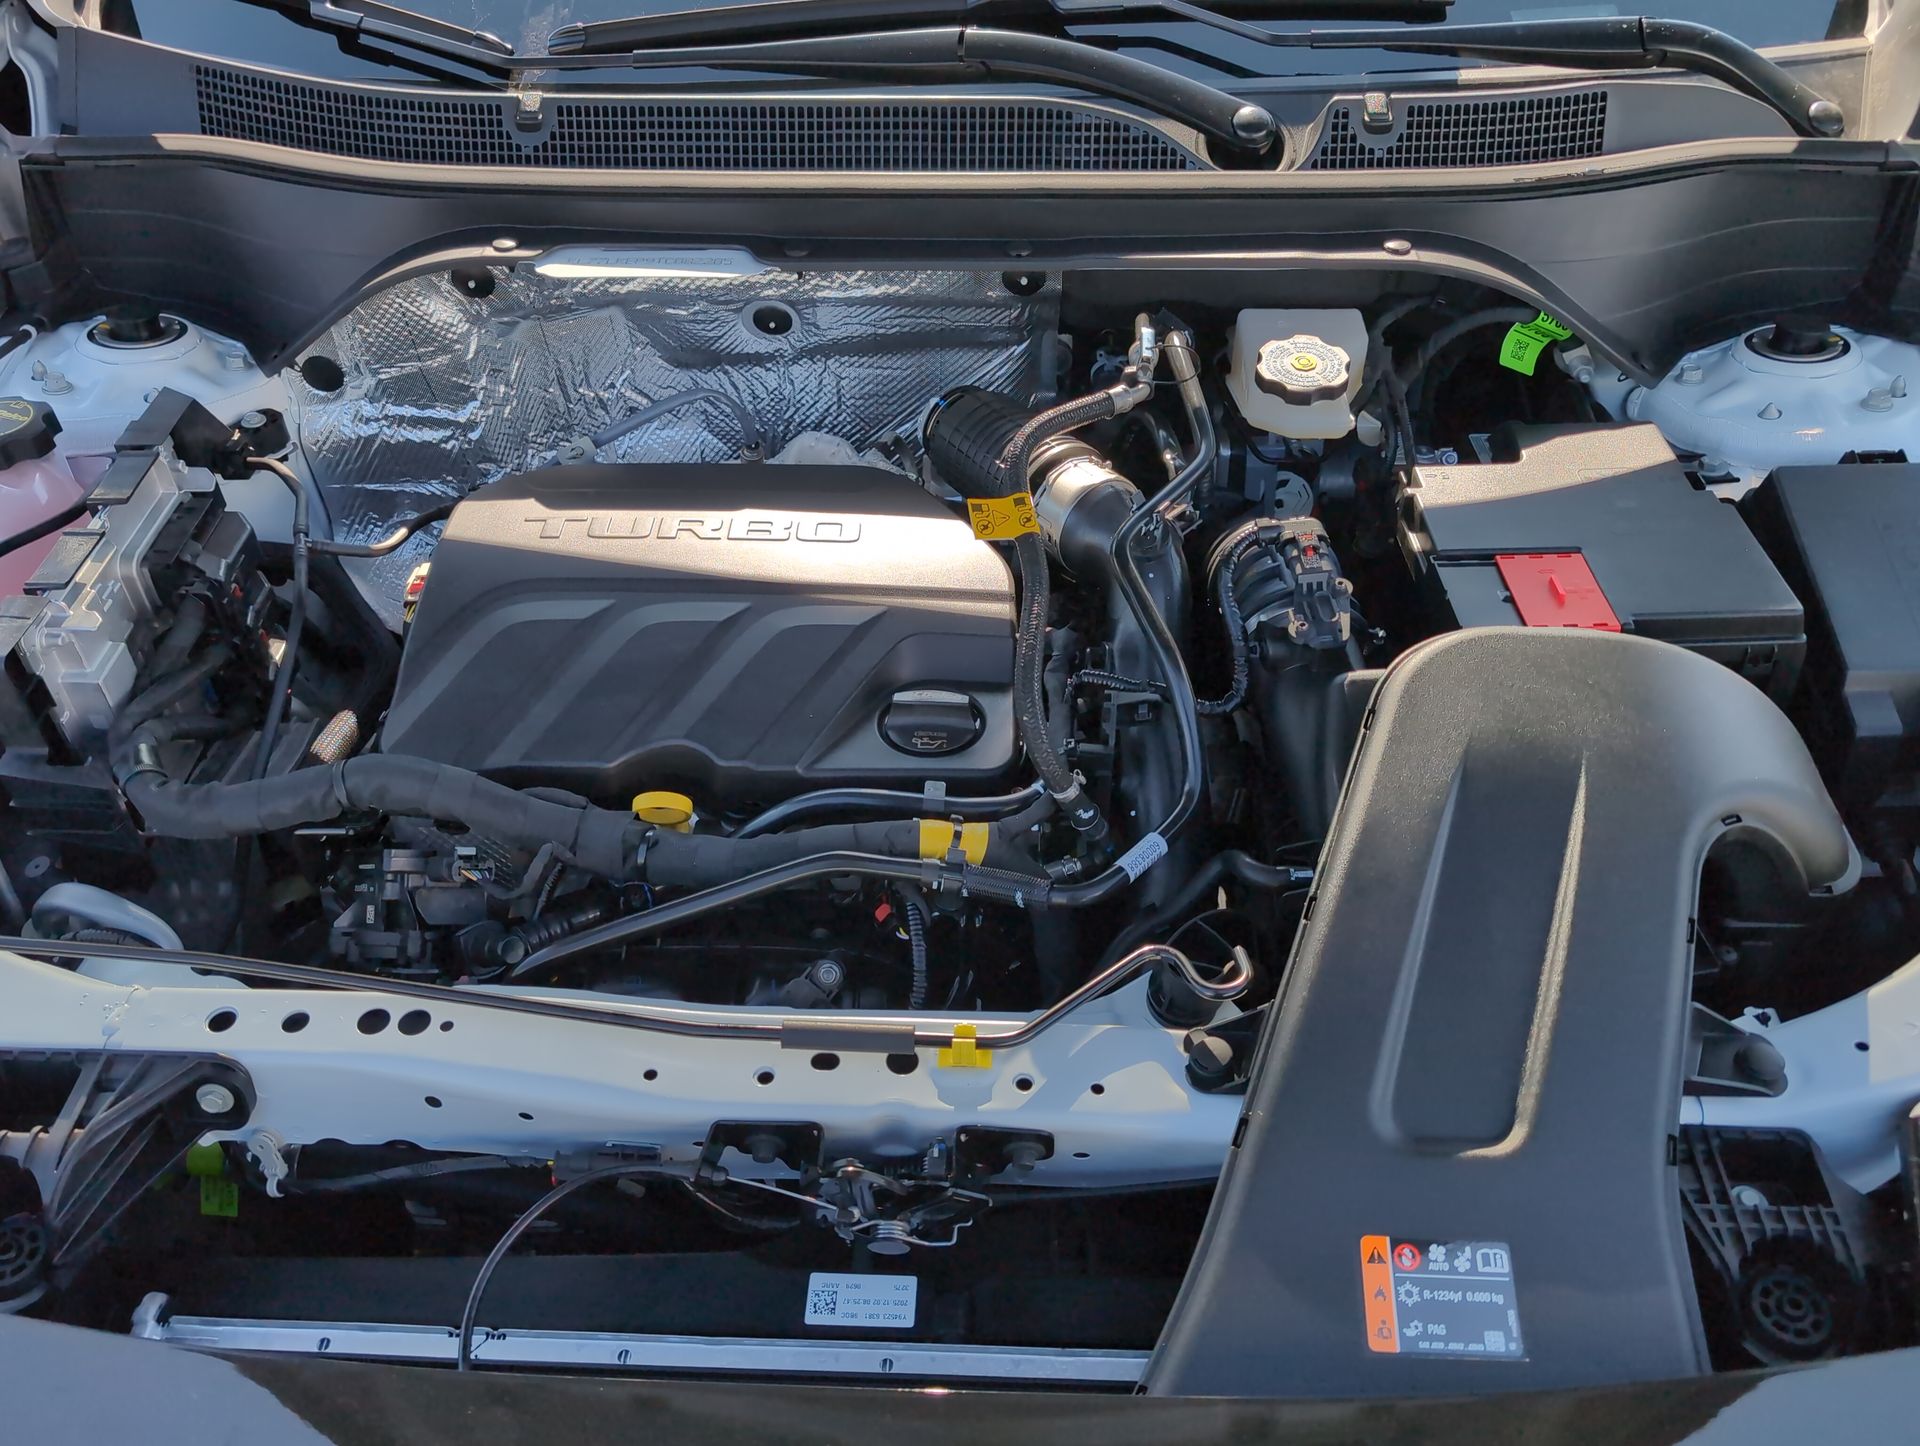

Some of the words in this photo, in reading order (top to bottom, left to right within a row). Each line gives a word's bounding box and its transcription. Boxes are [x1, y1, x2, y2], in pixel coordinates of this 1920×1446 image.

[524, 516, 862, 543] TURBO
[1428, 1262, 1449, 1271] AUTO
[1492, 1293, 1504, 1304] kg
[1427, 1323, 1446, 1335] PAG
